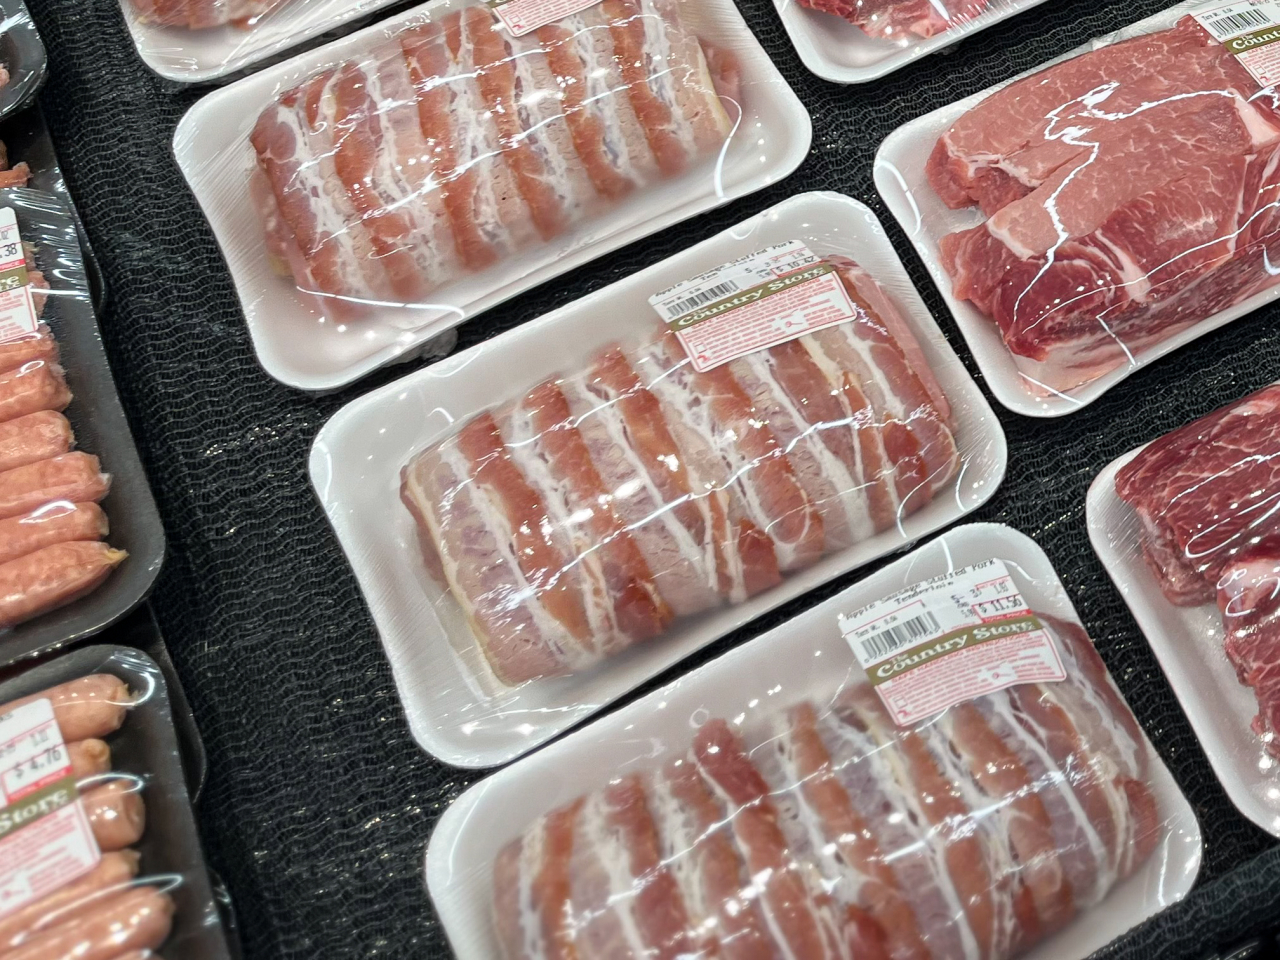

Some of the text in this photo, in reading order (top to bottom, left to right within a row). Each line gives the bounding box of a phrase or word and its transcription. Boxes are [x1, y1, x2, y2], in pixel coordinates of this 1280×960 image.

[772, 240, 795, 250] Pork
[678, 266, 823, 326] Country Store
[845, 603, 876, 621] Apple
[971, 557, 995, 572] Pork
[991, 594, 1023, 611] 11.56
[877, 635, 967, 677] Country
[972, 620, 1032, 640] Store
